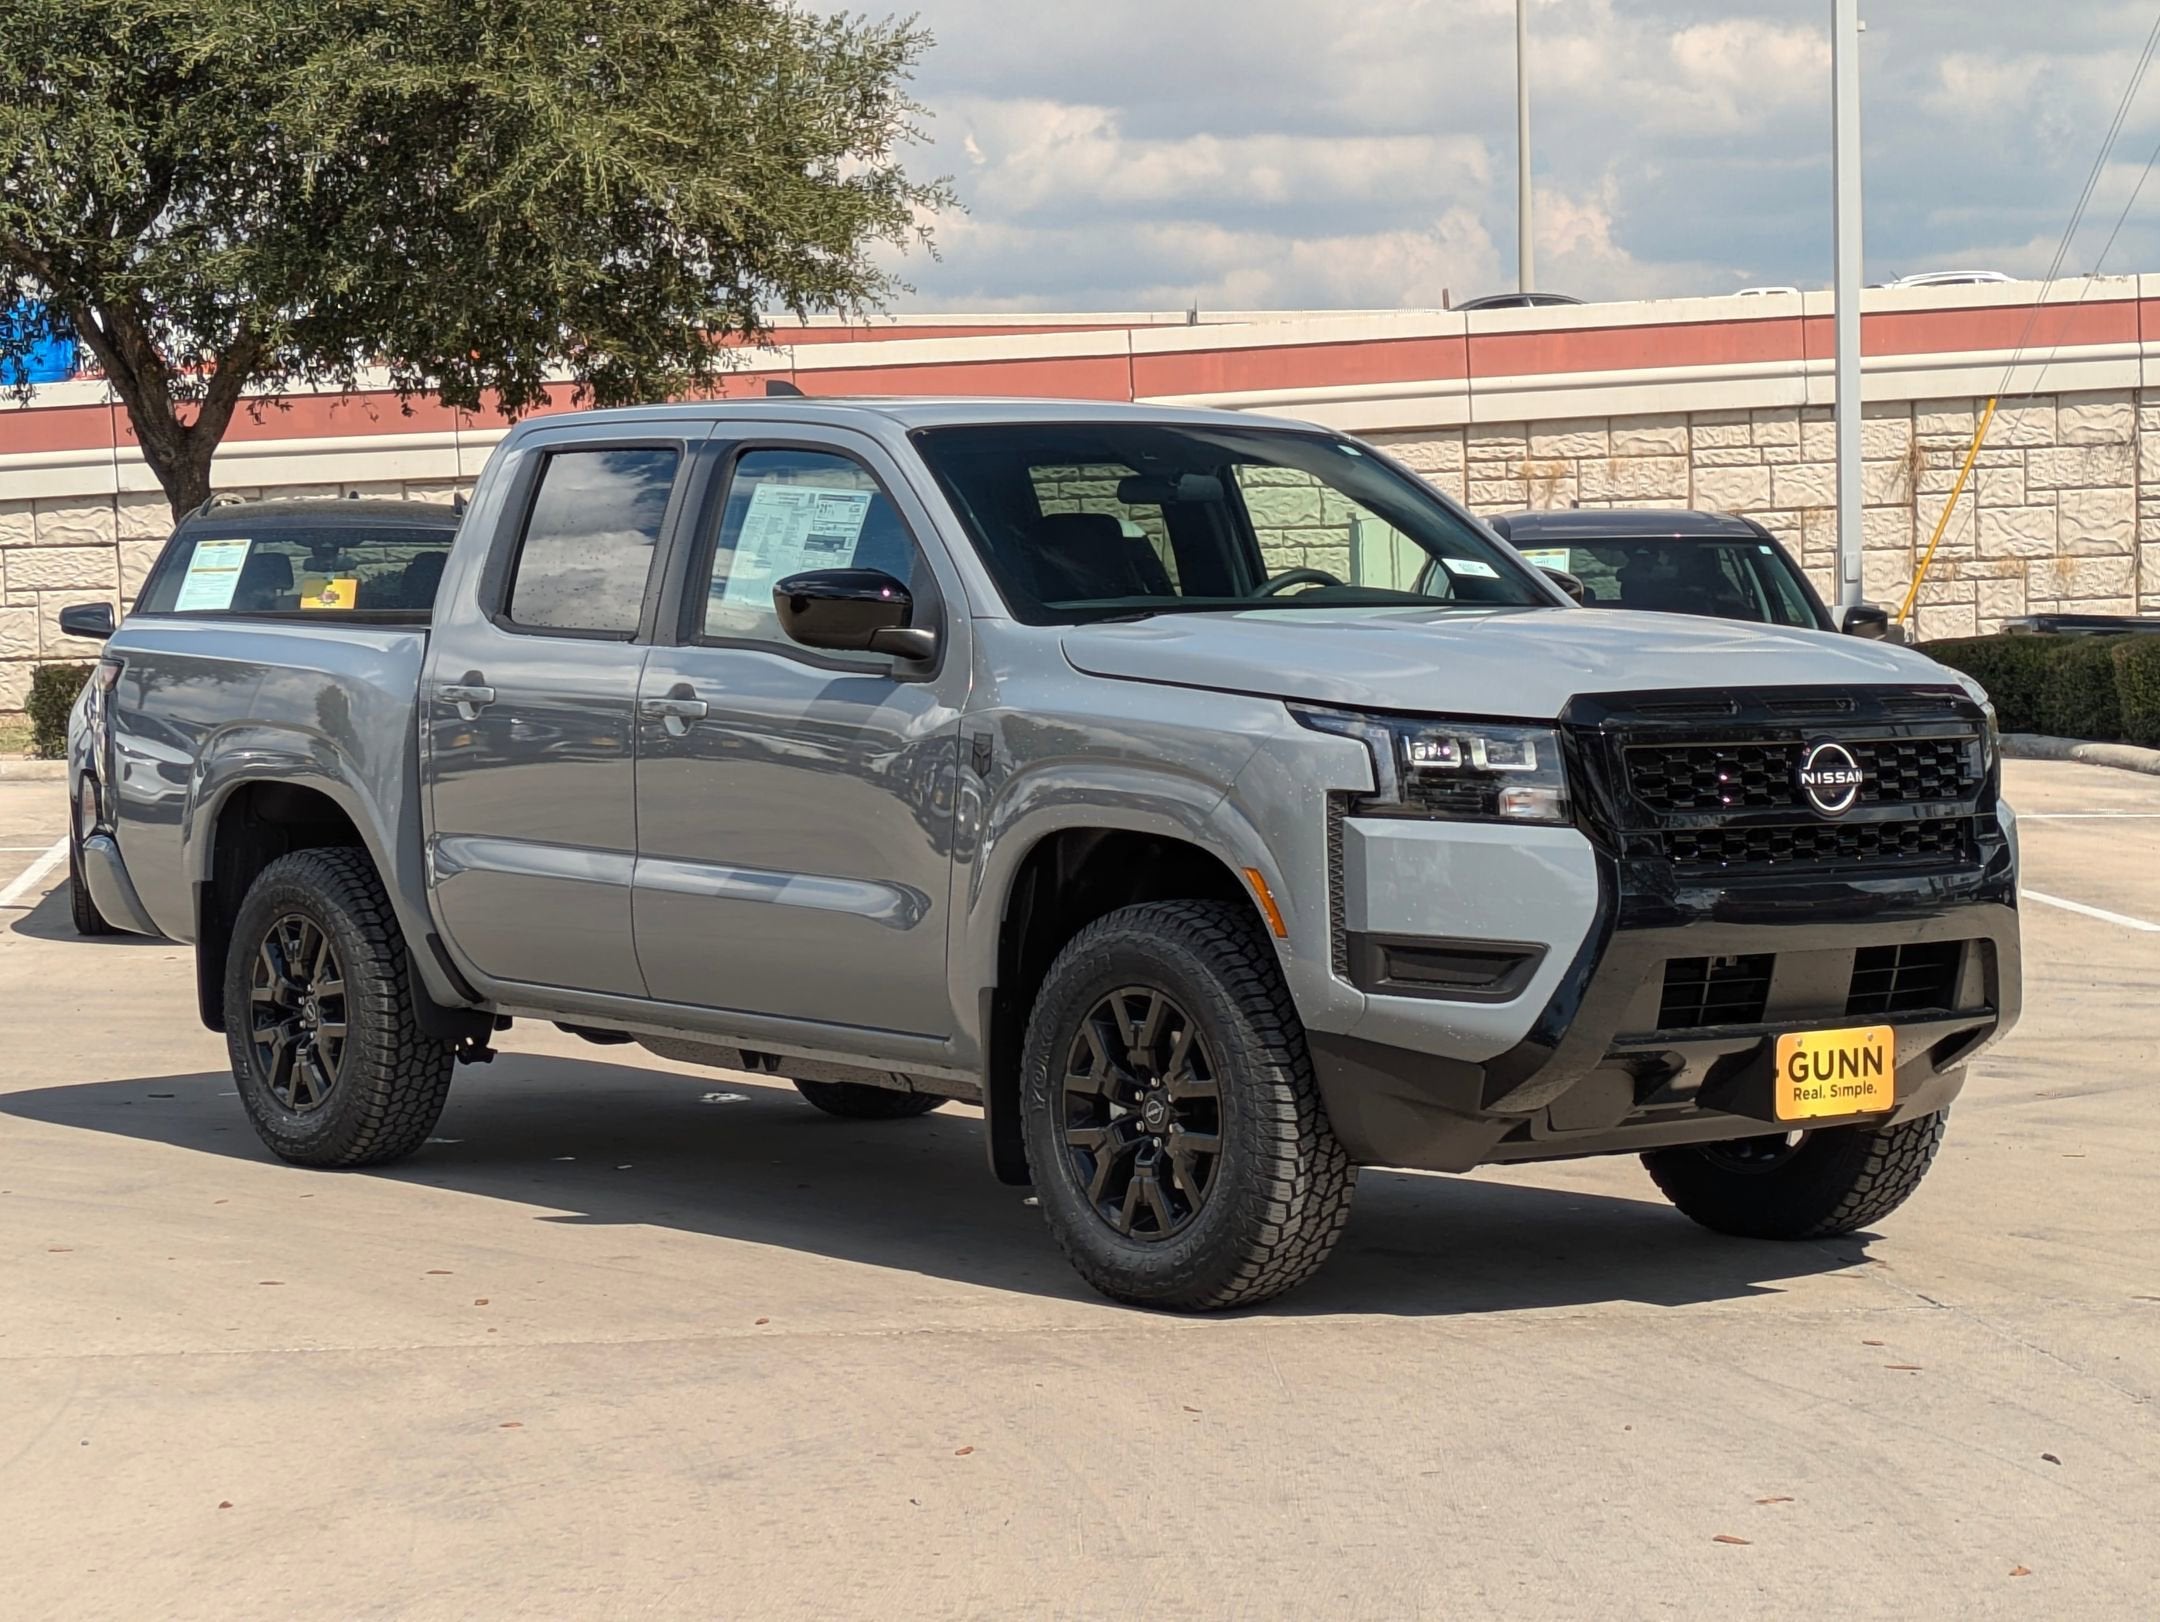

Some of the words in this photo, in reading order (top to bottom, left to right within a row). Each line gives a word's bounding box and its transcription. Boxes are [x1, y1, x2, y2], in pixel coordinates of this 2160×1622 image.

[1801, 770, 1863, 785] NISSAN
[1788, 1045, 1883, 1083] GUNN
[1793, 1084, 1826, 1102] Real.
[1830, 1080, 1878, 1099] Simple.
